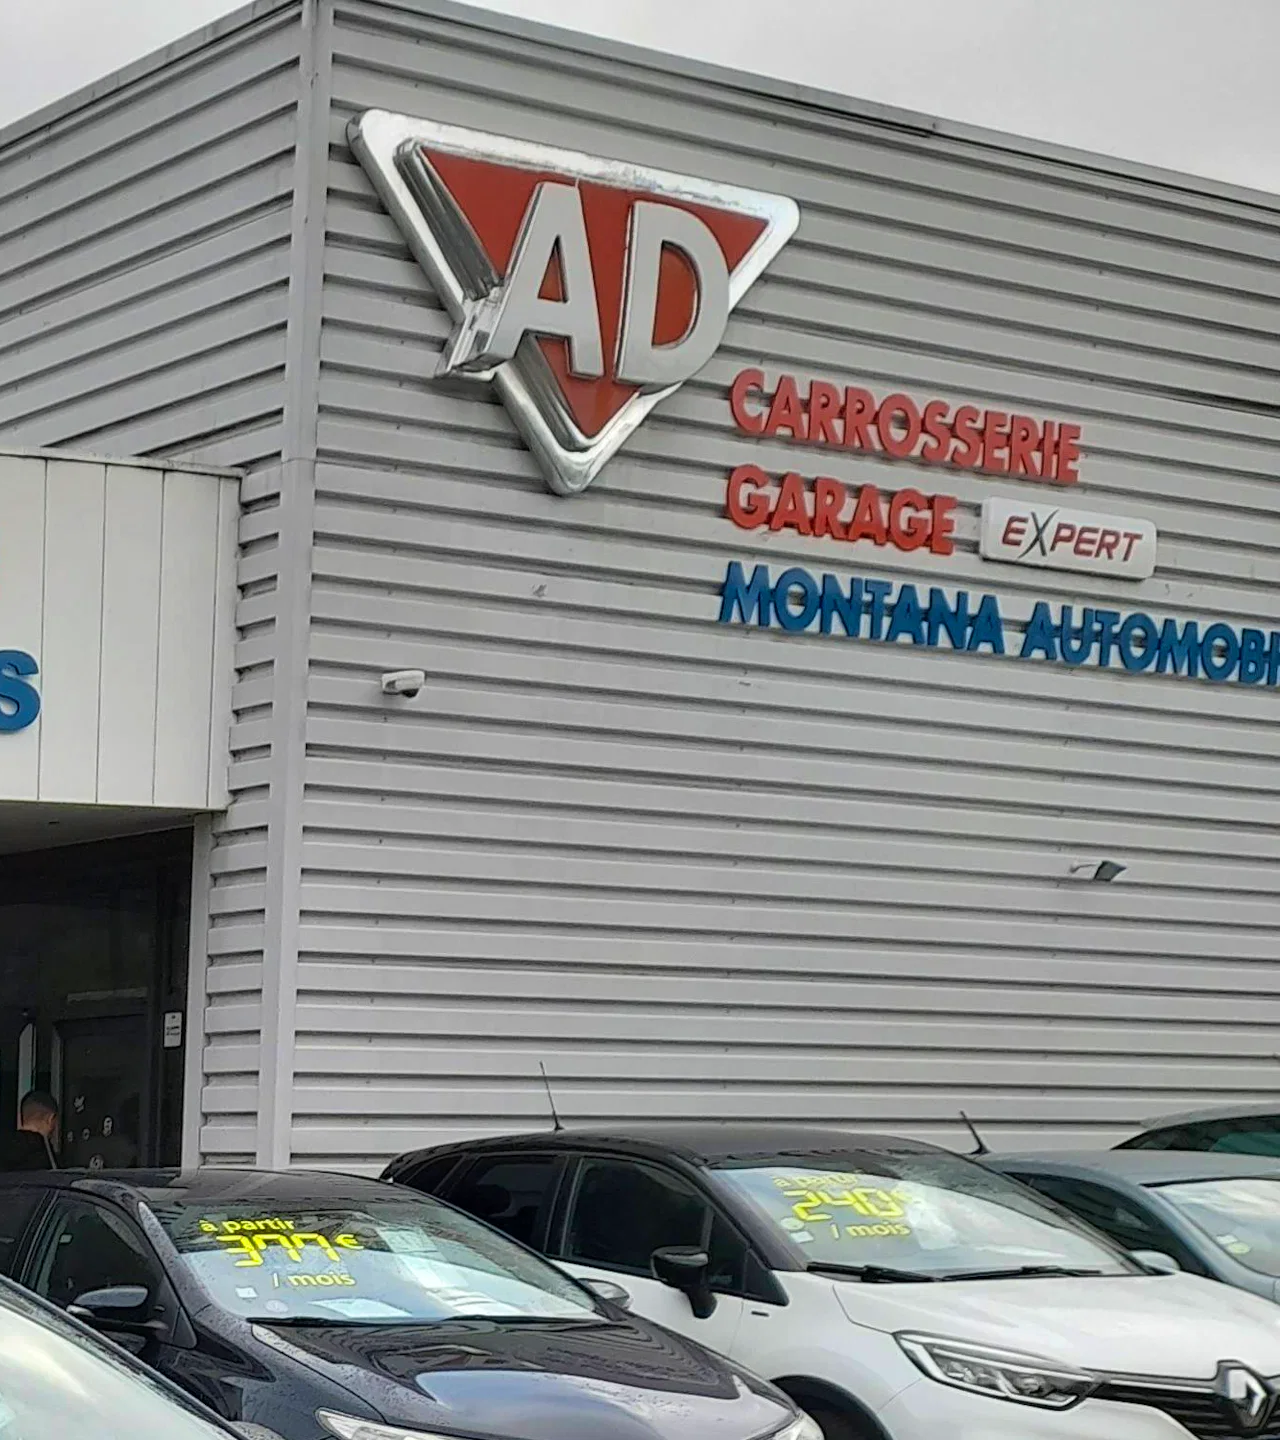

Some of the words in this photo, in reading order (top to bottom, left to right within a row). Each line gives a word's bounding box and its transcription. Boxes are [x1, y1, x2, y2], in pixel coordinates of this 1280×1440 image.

[483, 181, 731, 388] AD
[729, 367, 1081, 486] CARROSSERIE
[726, 463, 957, 556] GARAGE
[1002, 508, 1143, 563] EXPERT
[719, 561, 1005, 655] MONTANA
[199, 1219, 219, 1232] à
[223, 1217, 295, 1235] partir
[846, 1222, 912, 1238] mois
[287, 1272, 357, 1287] mois
